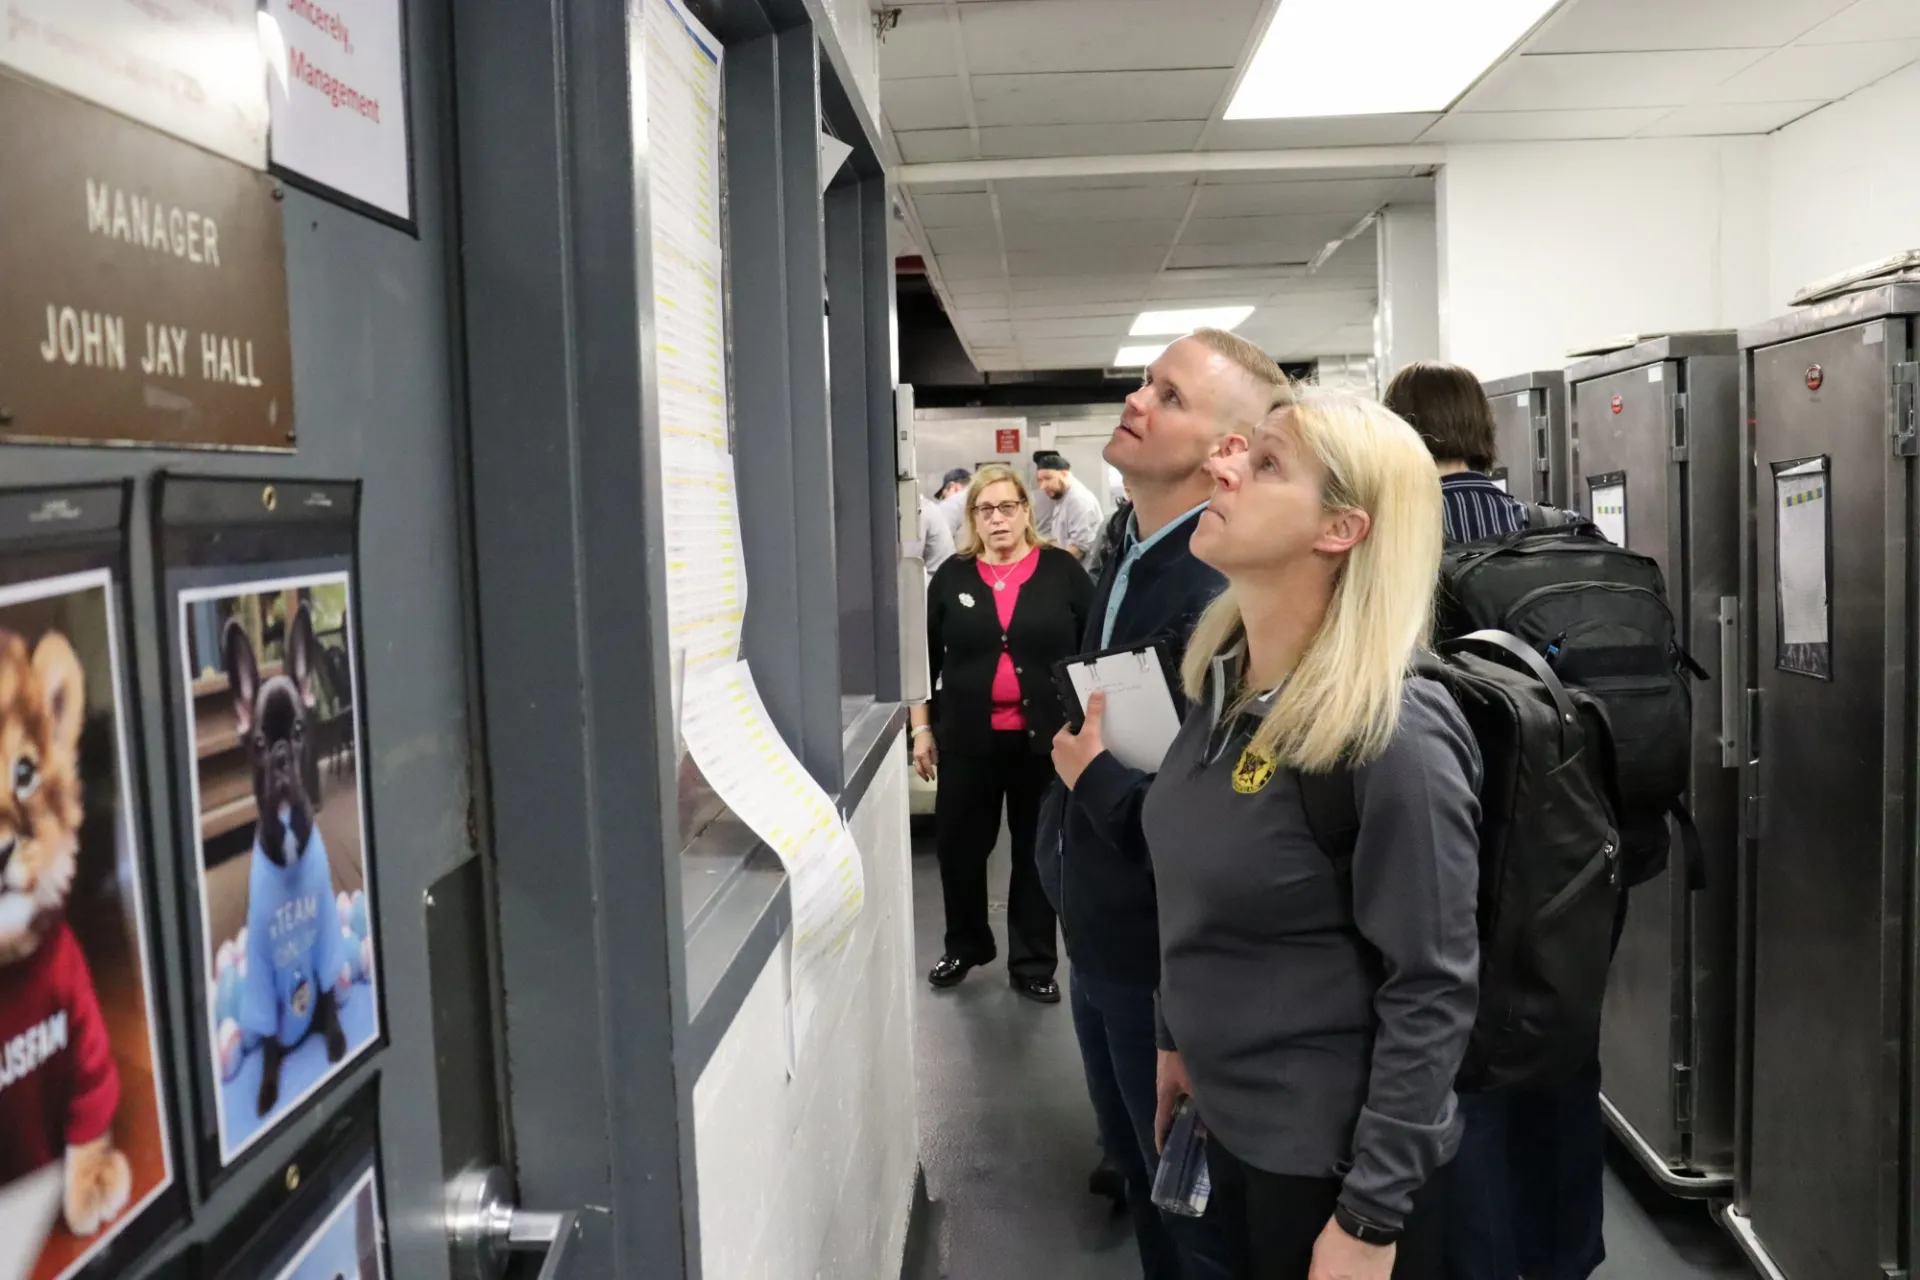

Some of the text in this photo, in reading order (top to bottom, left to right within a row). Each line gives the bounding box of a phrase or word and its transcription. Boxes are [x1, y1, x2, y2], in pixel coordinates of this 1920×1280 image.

[290, 45, 380, 124] Management
[86, 178, 220, 267] MANAGER
[40, 304, 262, 388] JOHN JAY HALL
